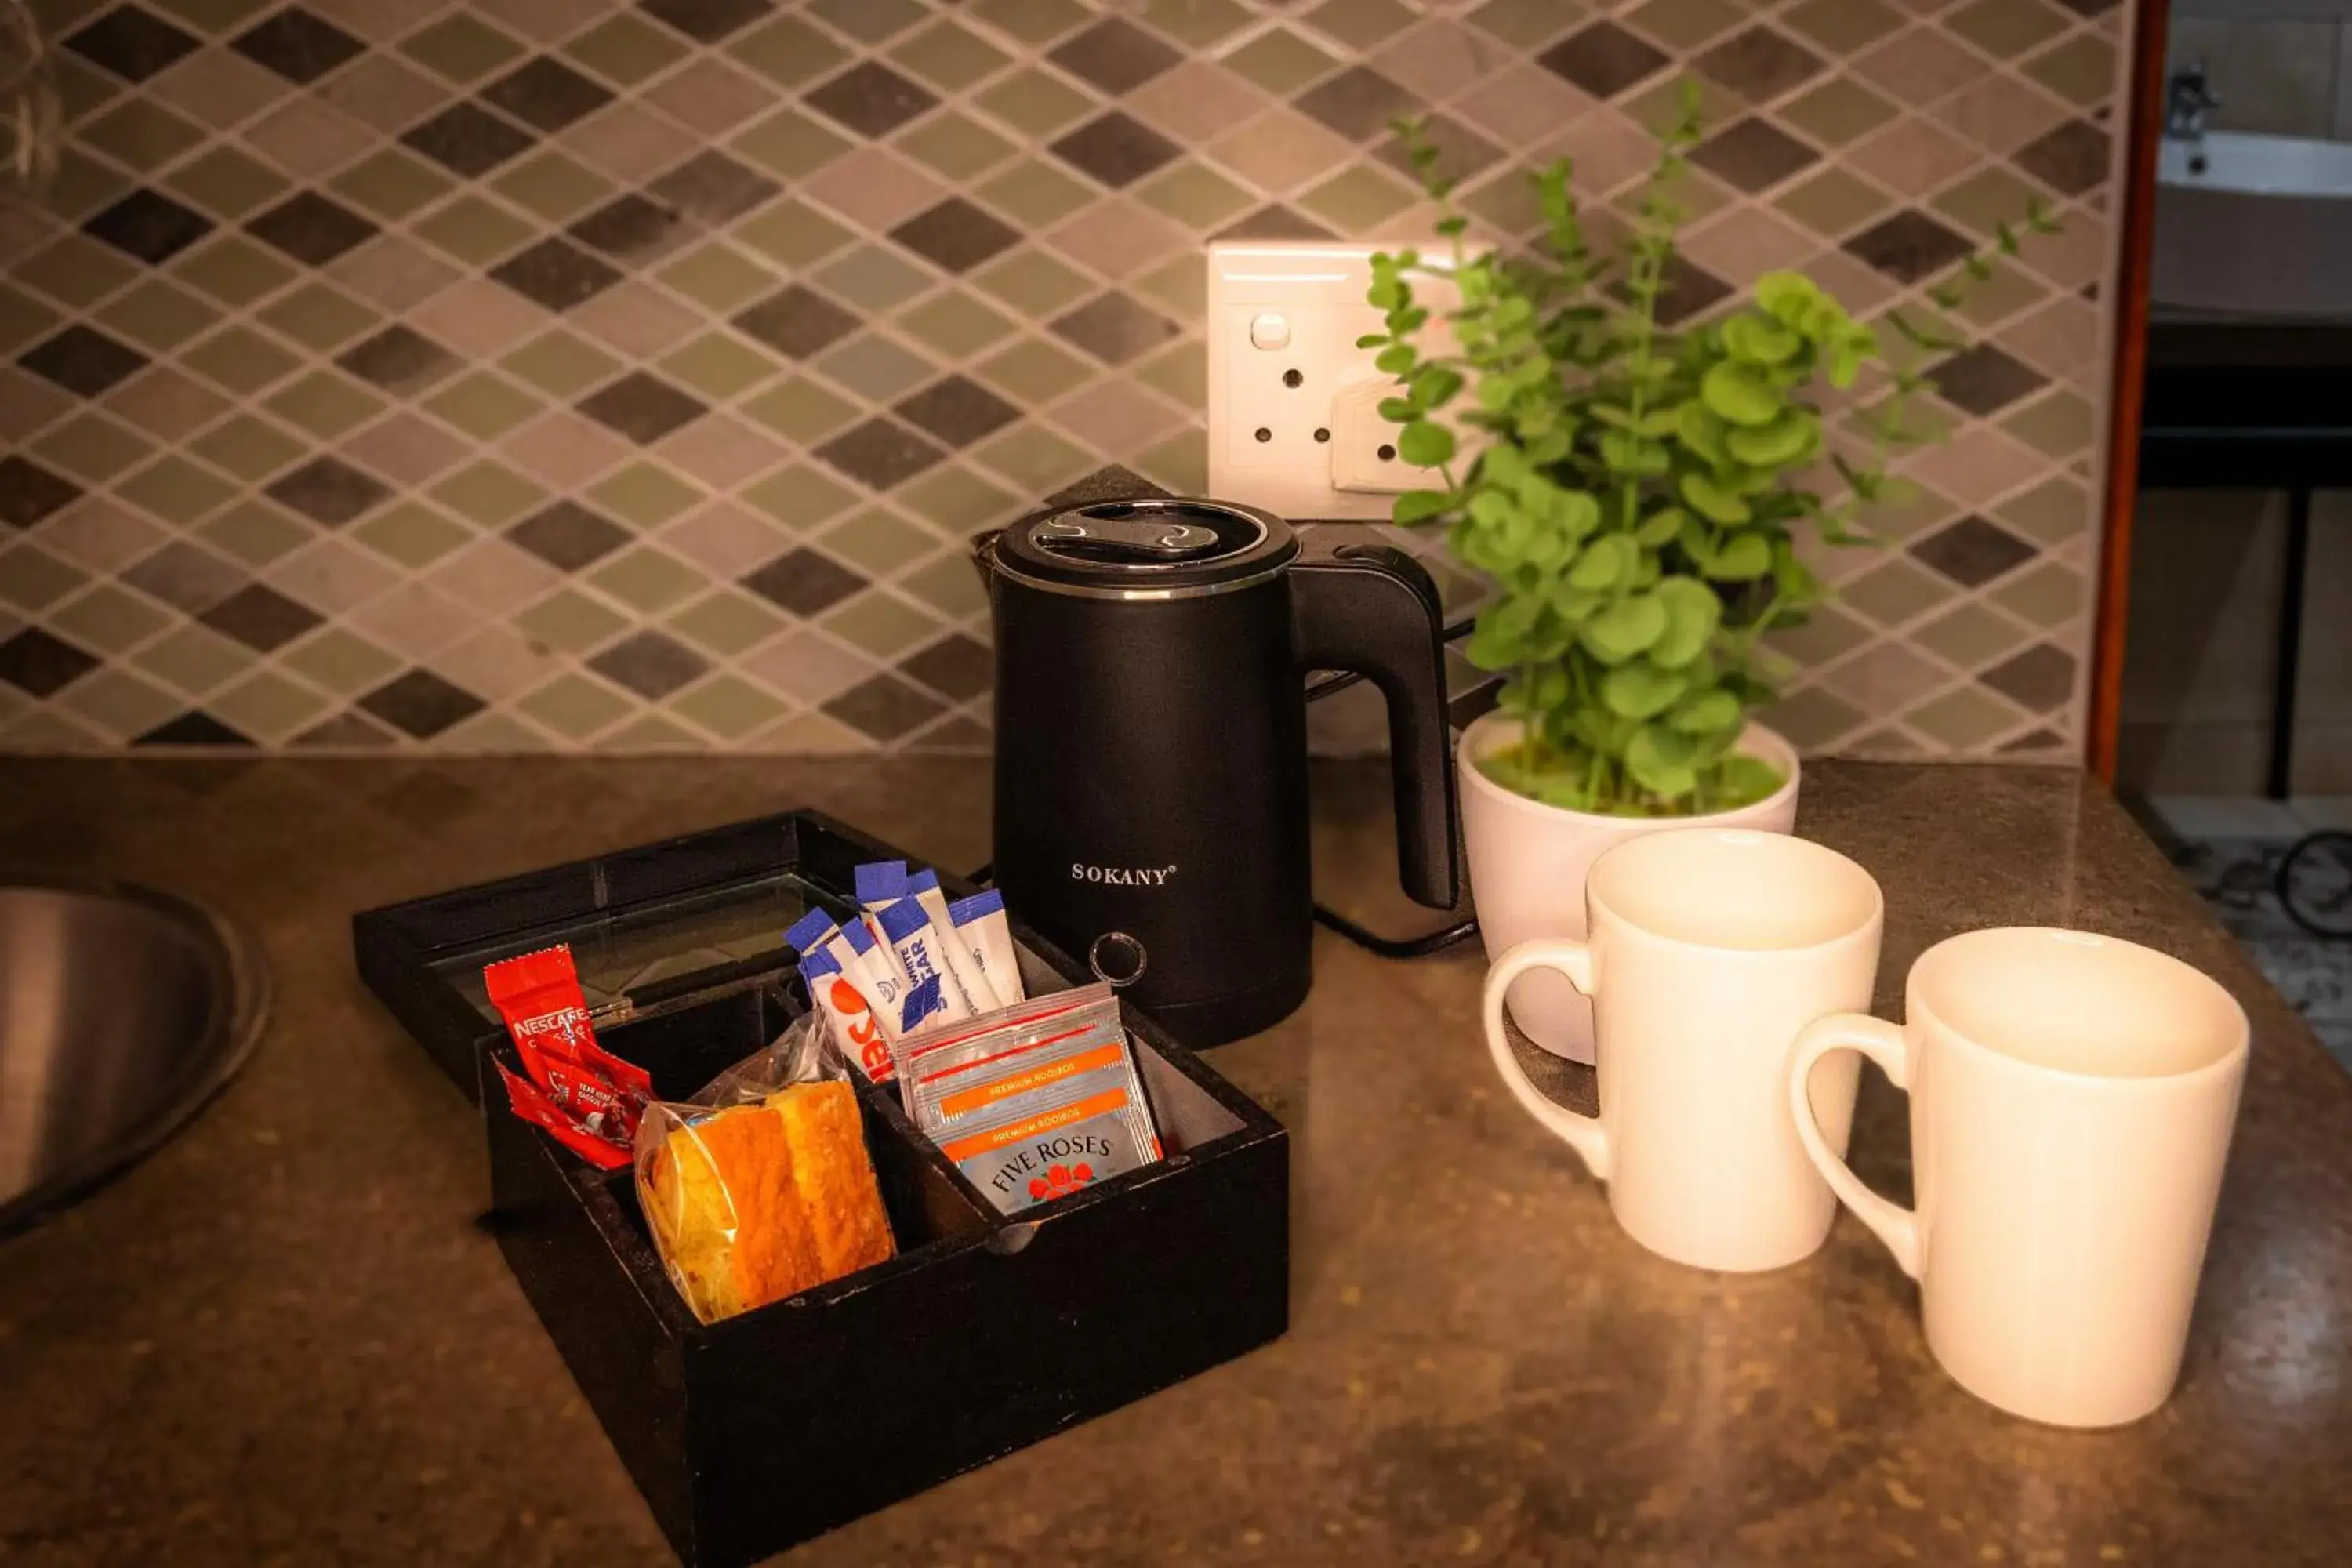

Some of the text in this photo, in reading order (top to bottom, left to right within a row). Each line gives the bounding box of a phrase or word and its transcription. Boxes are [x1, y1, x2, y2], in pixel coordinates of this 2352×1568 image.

[1072, 863, 1167, 885] SOKANY
[899, 946, 920, 988] WHITE
[992, 1136, 1112, 1193] FIVE ROSES
